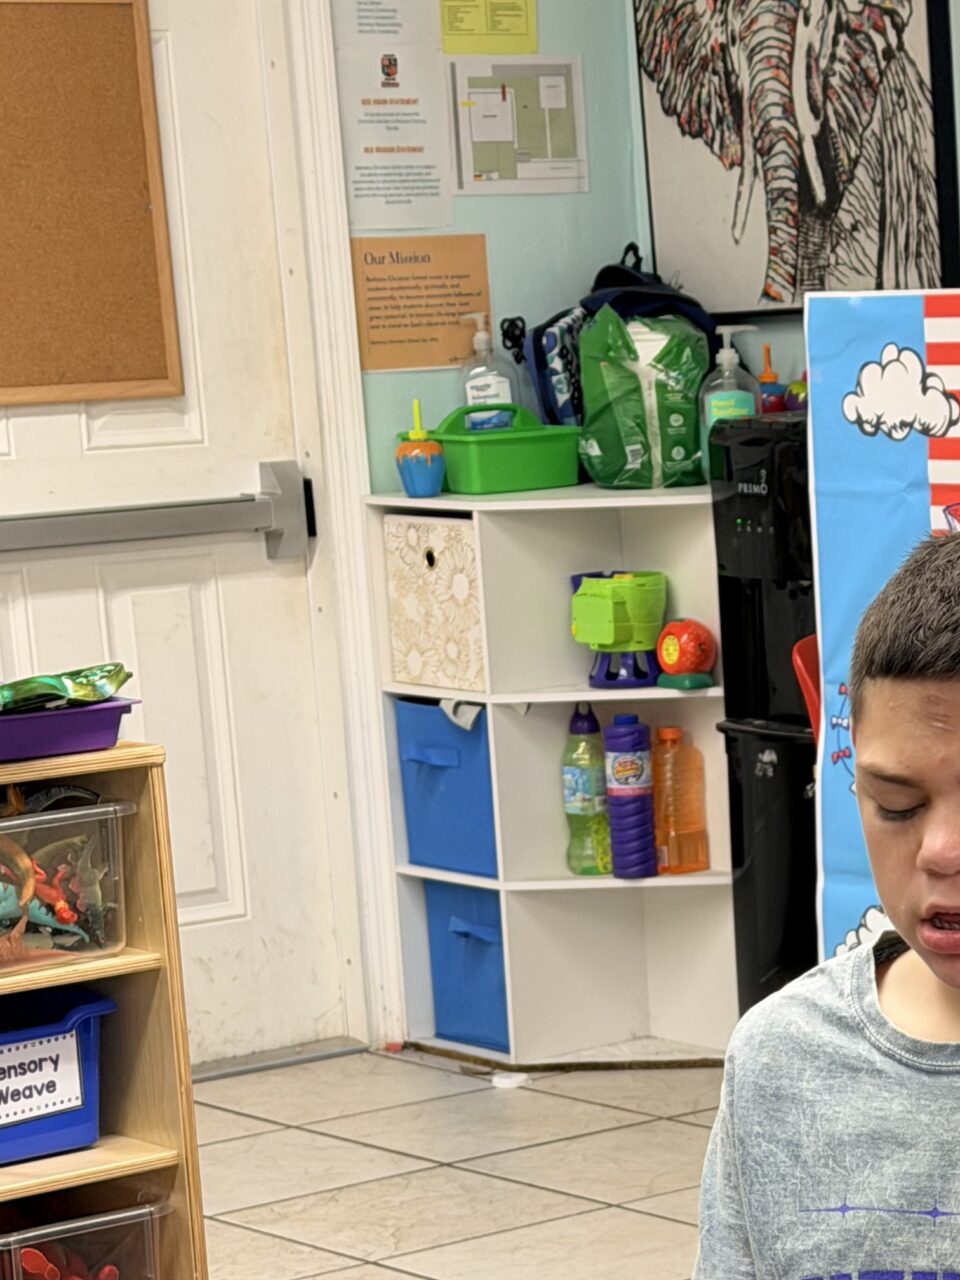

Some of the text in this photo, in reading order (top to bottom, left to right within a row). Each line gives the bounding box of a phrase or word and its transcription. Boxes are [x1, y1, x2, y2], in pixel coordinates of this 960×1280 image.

[364, 251, 431, 265] Our Mission
[711, 398, 737, 408] Hand
[737, 482, 768, 495] PRIMO
[0, 1053, 60, 1079] ensory
